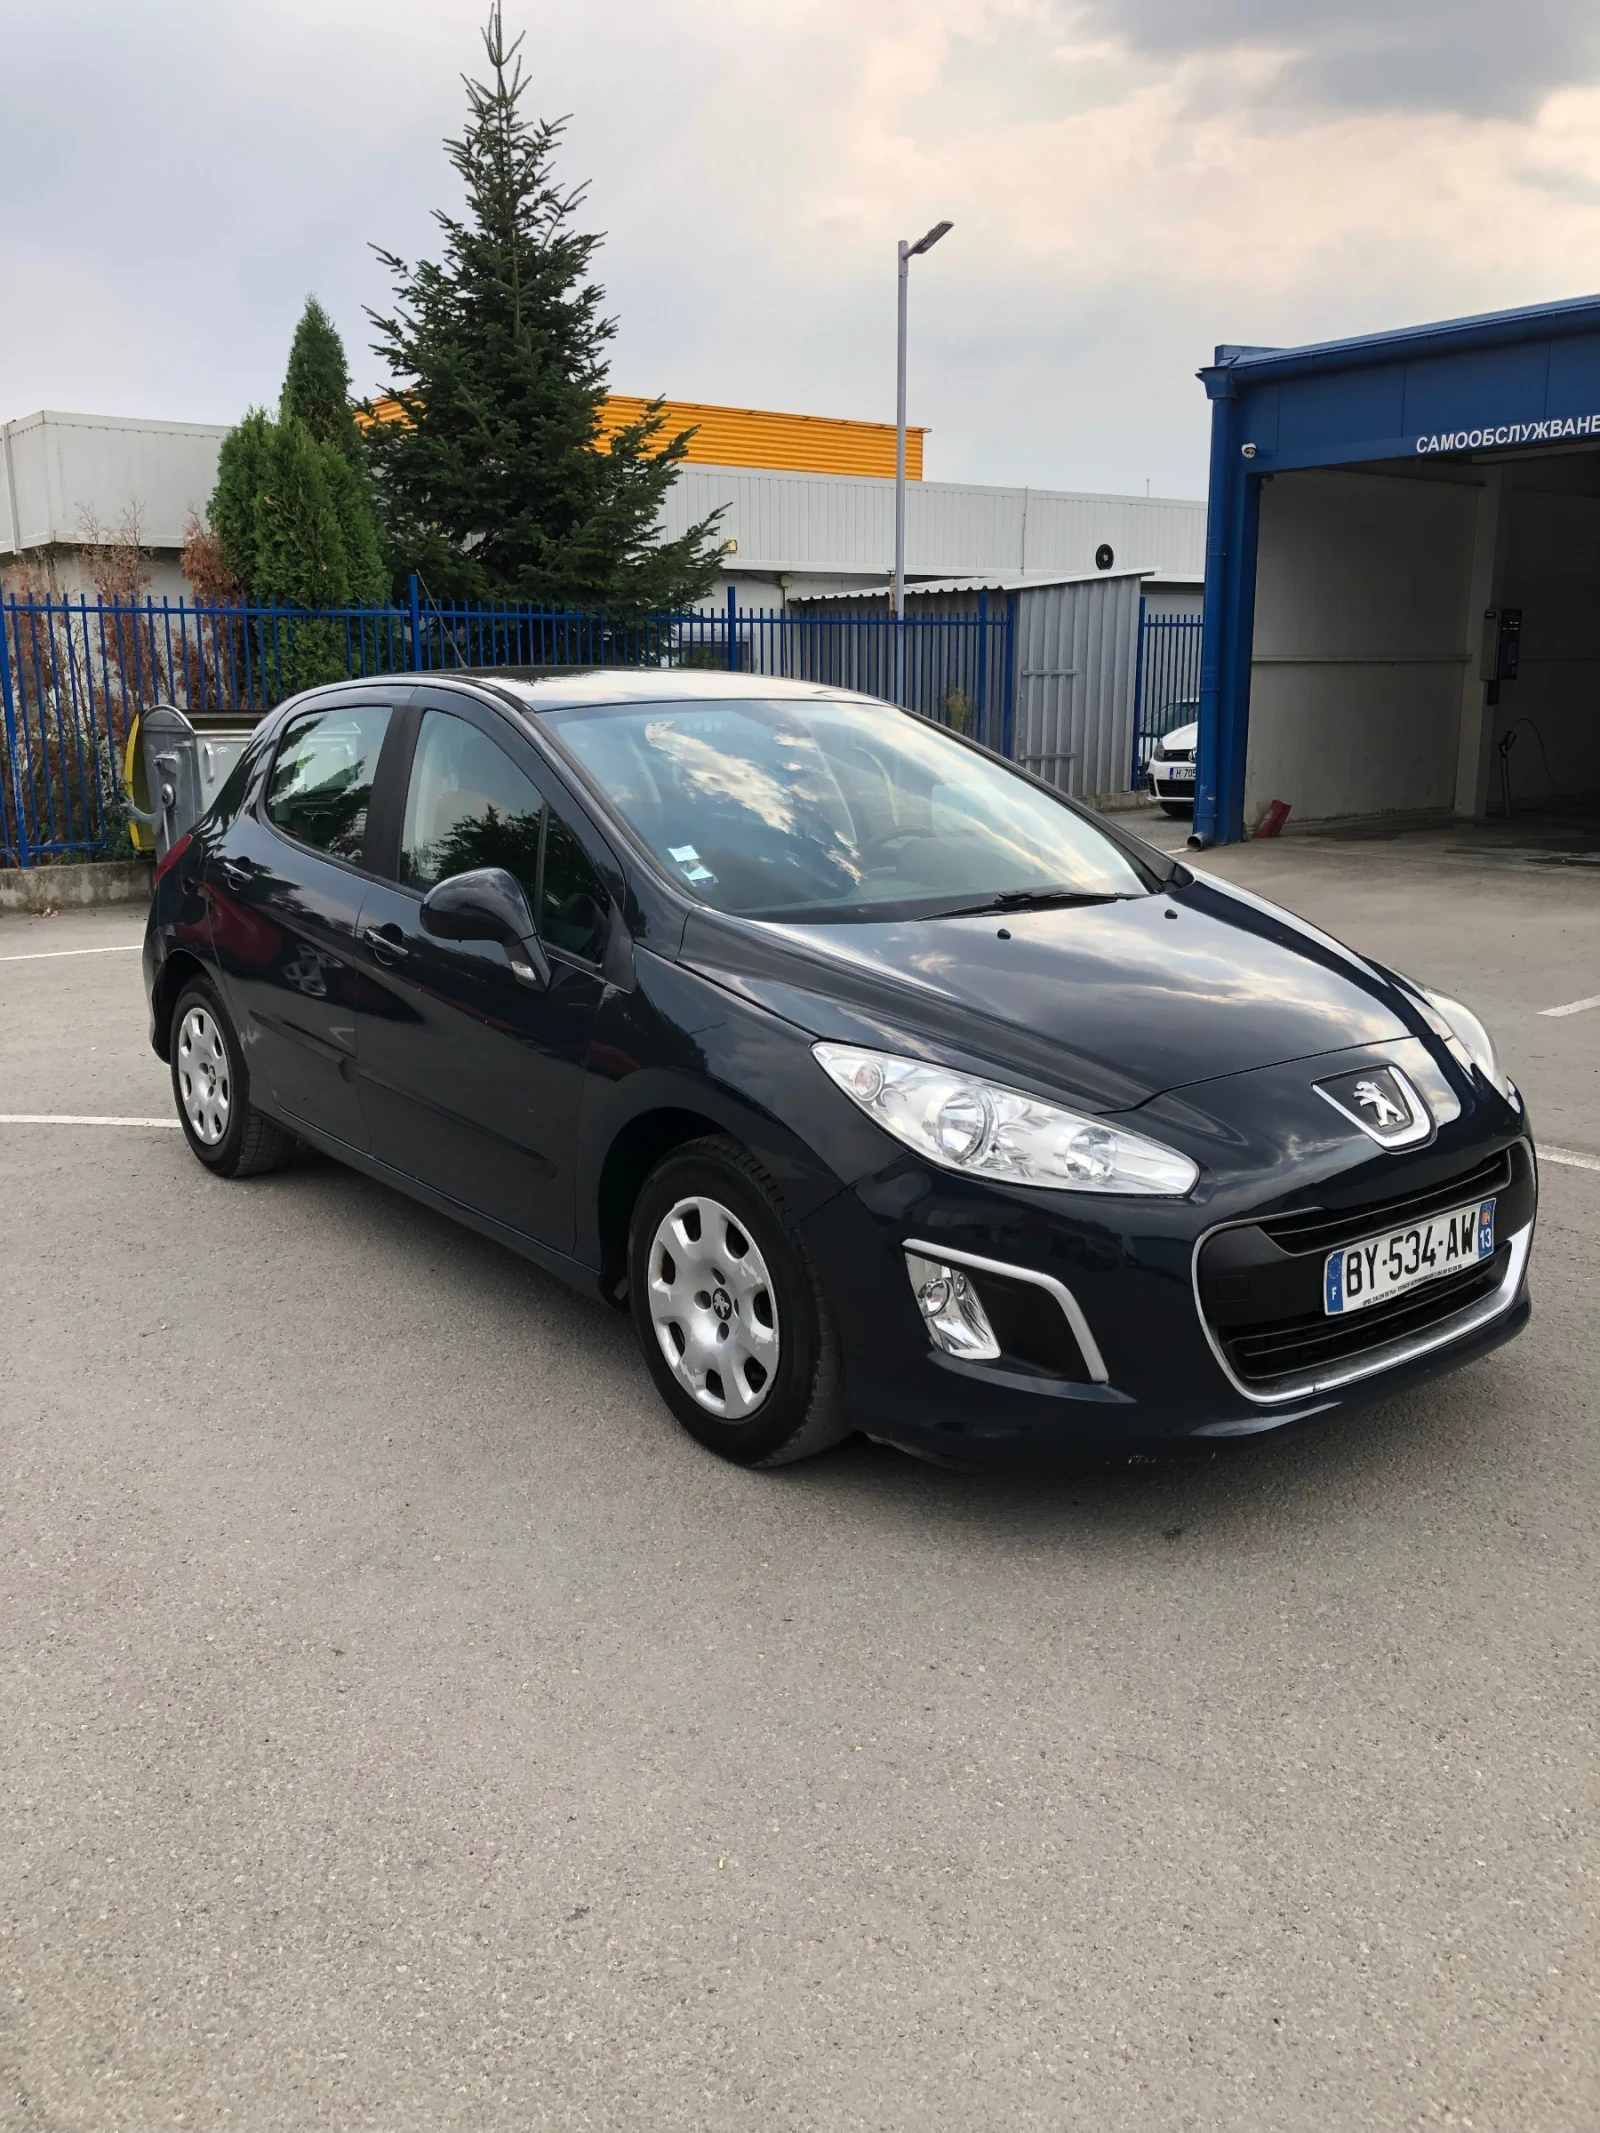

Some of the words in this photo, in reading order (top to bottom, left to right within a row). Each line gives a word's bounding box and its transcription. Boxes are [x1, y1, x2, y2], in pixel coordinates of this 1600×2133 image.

[1332, 1287, 1337, 1300] F
[1346, 1211, 1477, 1299] BY-534-AW
[1479, 1228, 1491, 1249] 13
